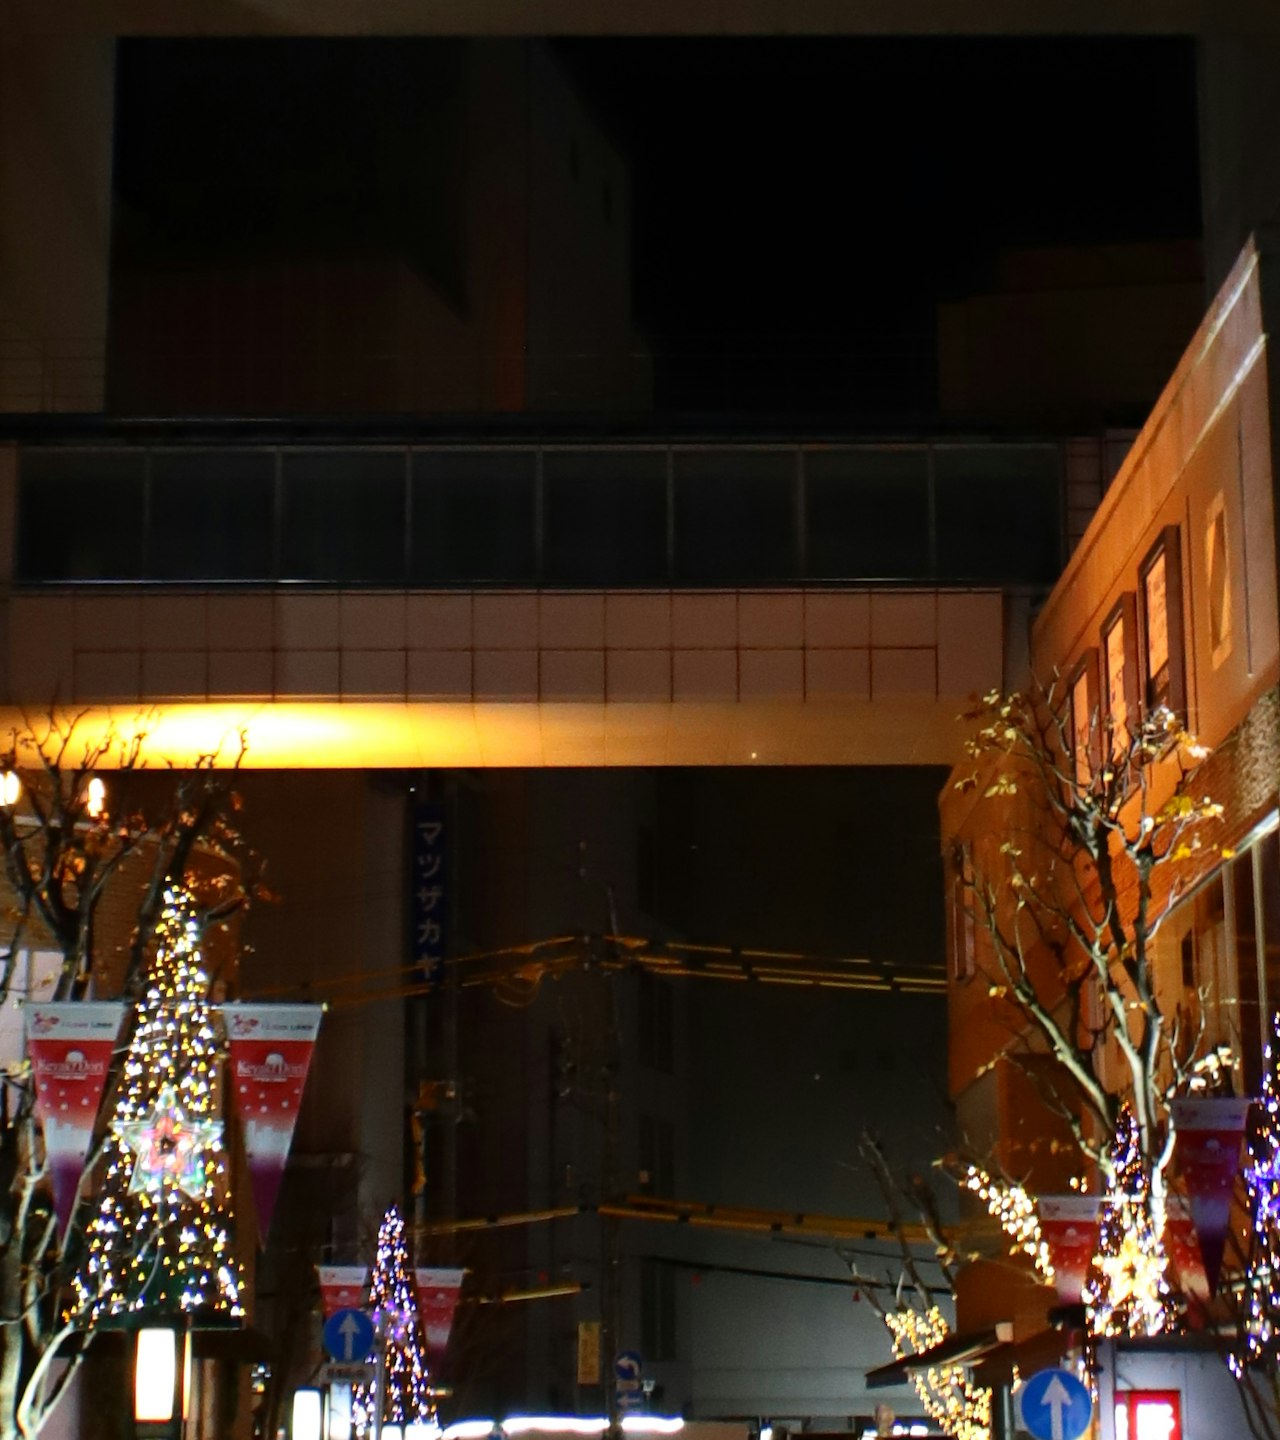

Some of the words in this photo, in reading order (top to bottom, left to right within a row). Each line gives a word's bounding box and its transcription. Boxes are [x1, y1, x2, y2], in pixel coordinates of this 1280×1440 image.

[416, 821, 444, 981] マツザカヤ
